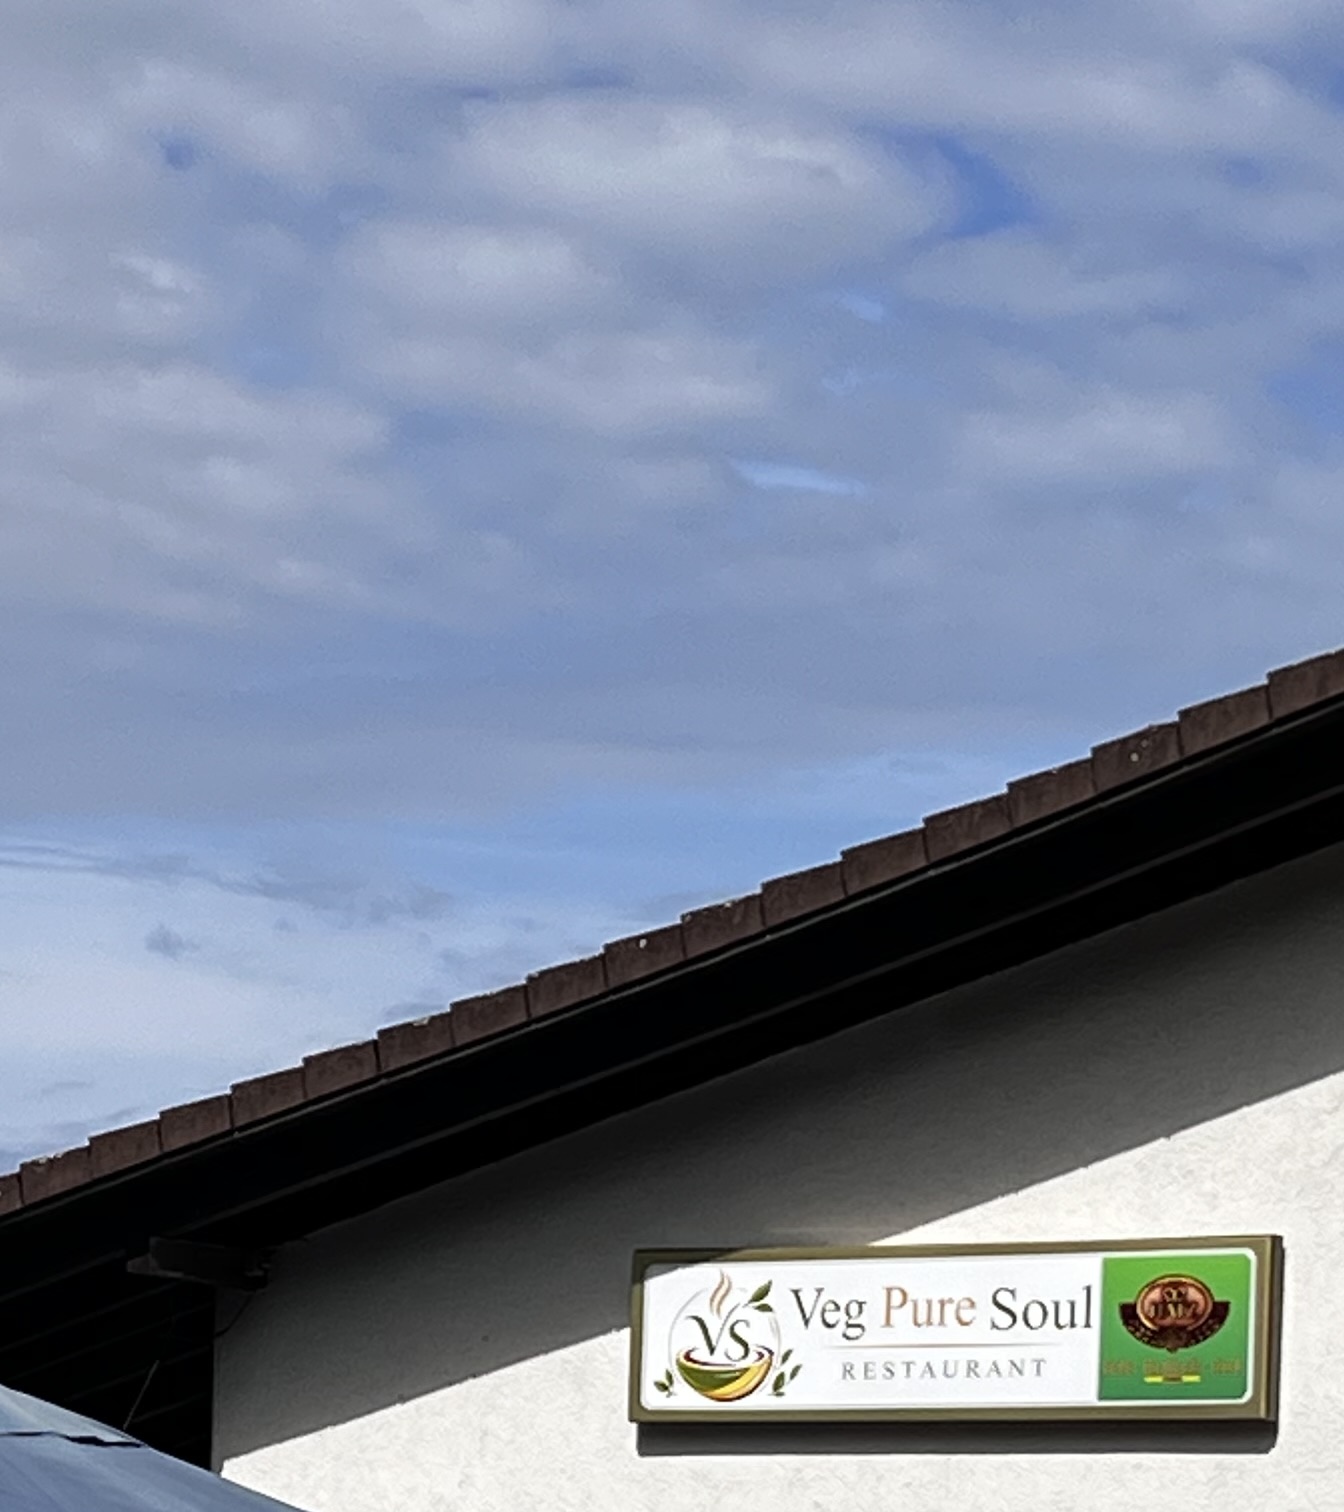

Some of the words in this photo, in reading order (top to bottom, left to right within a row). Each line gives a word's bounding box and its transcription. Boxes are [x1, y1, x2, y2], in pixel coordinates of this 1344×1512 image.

[685, 1302, 750, 1362] VS
[789, 1287, 866, 1341] Veg
[881, 1286, 976, 1329] Pure
[990, 1285, 1093, 1331] Soul
[841, 1357, 1047, 1382] RESTAURANT
